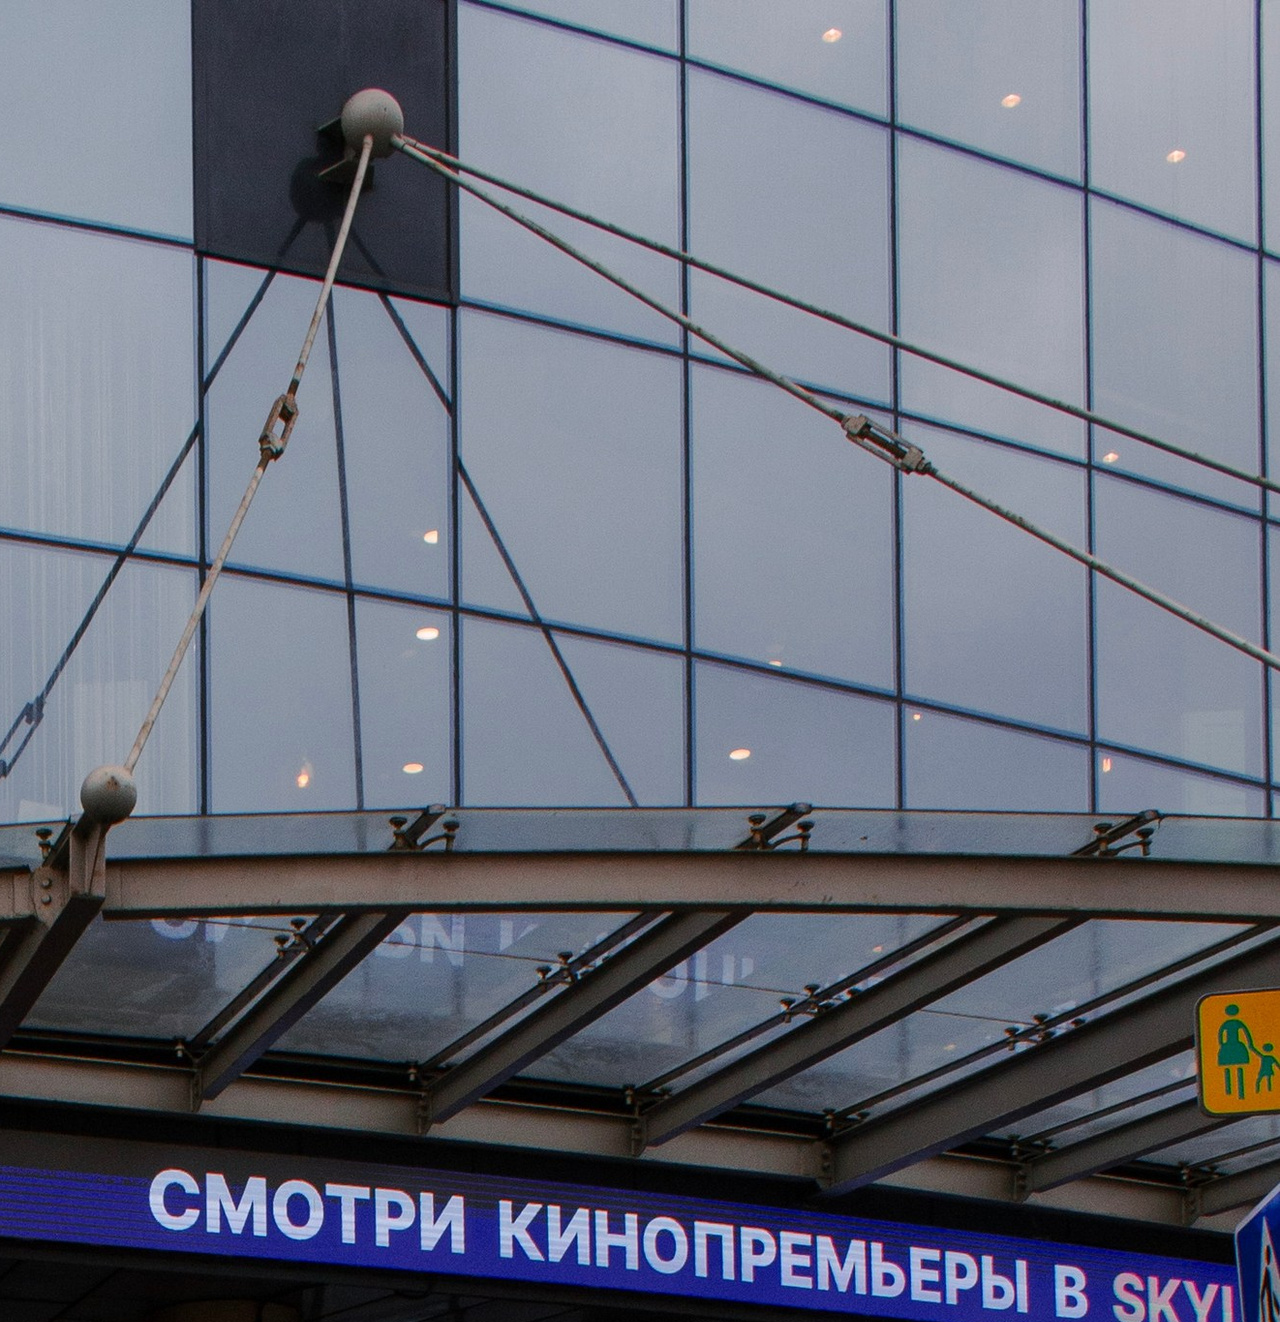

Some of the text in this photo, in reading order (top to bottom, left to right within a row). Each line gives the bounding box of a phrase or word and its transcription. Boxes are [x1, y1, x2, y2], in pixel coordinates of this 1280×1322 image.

[148, 1167, 466, 1256] СМОТРИ
[498, 1198, 1028, 1314] КИНОПРЕМЬЕРЫ
[1054, 1263, 1089, 1320] В
